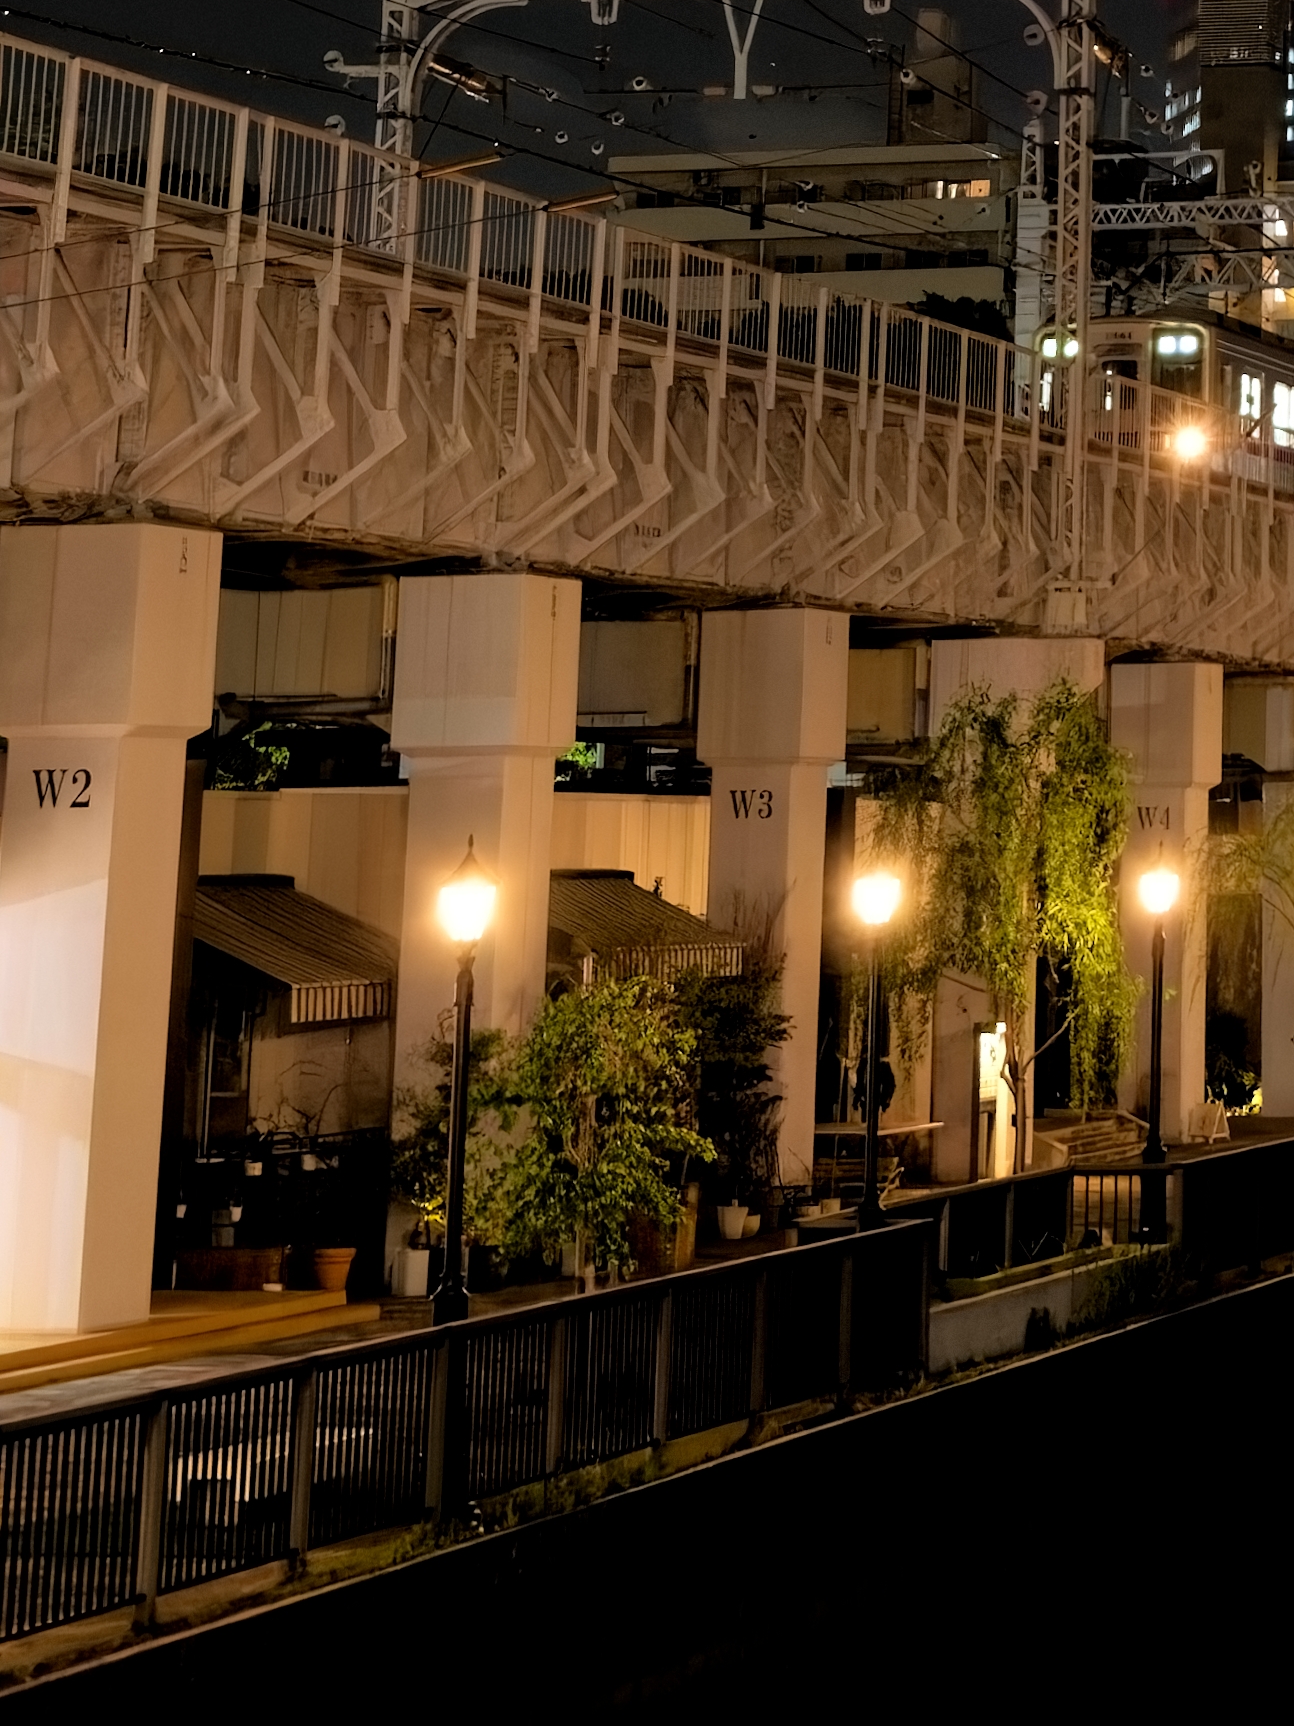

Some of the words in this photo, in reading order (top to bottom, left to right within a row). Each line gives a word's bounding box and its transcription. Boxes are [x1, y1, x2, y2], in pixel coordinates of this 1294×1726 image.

[32, 768, 92, 809] W2
[729, 789, 773, 819] W3
[1137, 805, 1170, 830] W4
